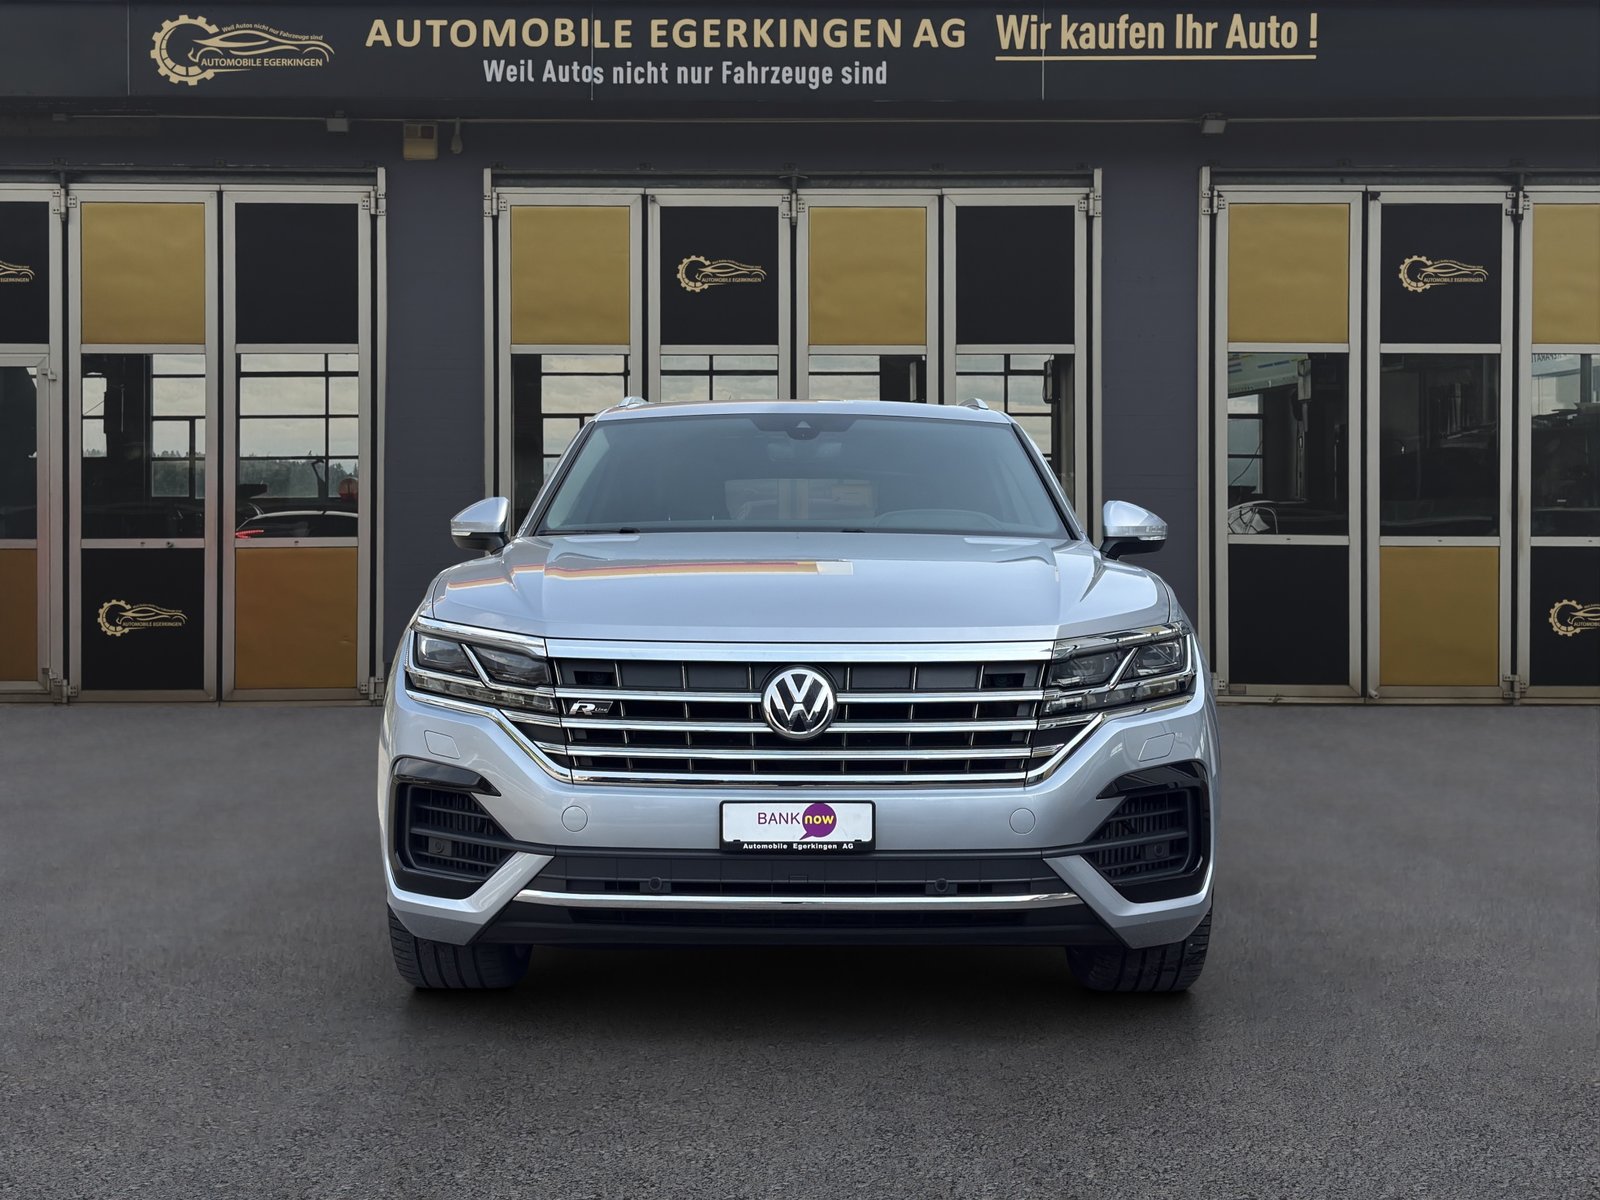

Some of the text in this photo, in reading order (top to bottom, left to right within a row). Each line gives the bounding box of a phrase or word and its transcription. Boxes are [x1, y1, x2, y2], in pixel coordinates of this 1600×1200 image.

[222, 24, 235, 33] Weil
[254, 23, 270, 32] nicht
[280, 31, 311, 41] Fahrzeuge
[365, 18, 966, 49] AUTOMOBILE EGERKINGEN AG
[996, 15, 1052, 50] Wir
[1061, 14, 1165, 50] kaufen
[1176, 14, 1219, 49] Ihr
[1226, 14, 1298, 49] Auto
[201, 58, 323, 67] AUTOMOBILE EGERKINGEN
[483, 60, 887, 90] Weil Autos nicht nur Fahrzeuge sind
[757, 812, 835, 825] BANK now
[743, 842, 854, 851] Automobile Egerkingen AG
